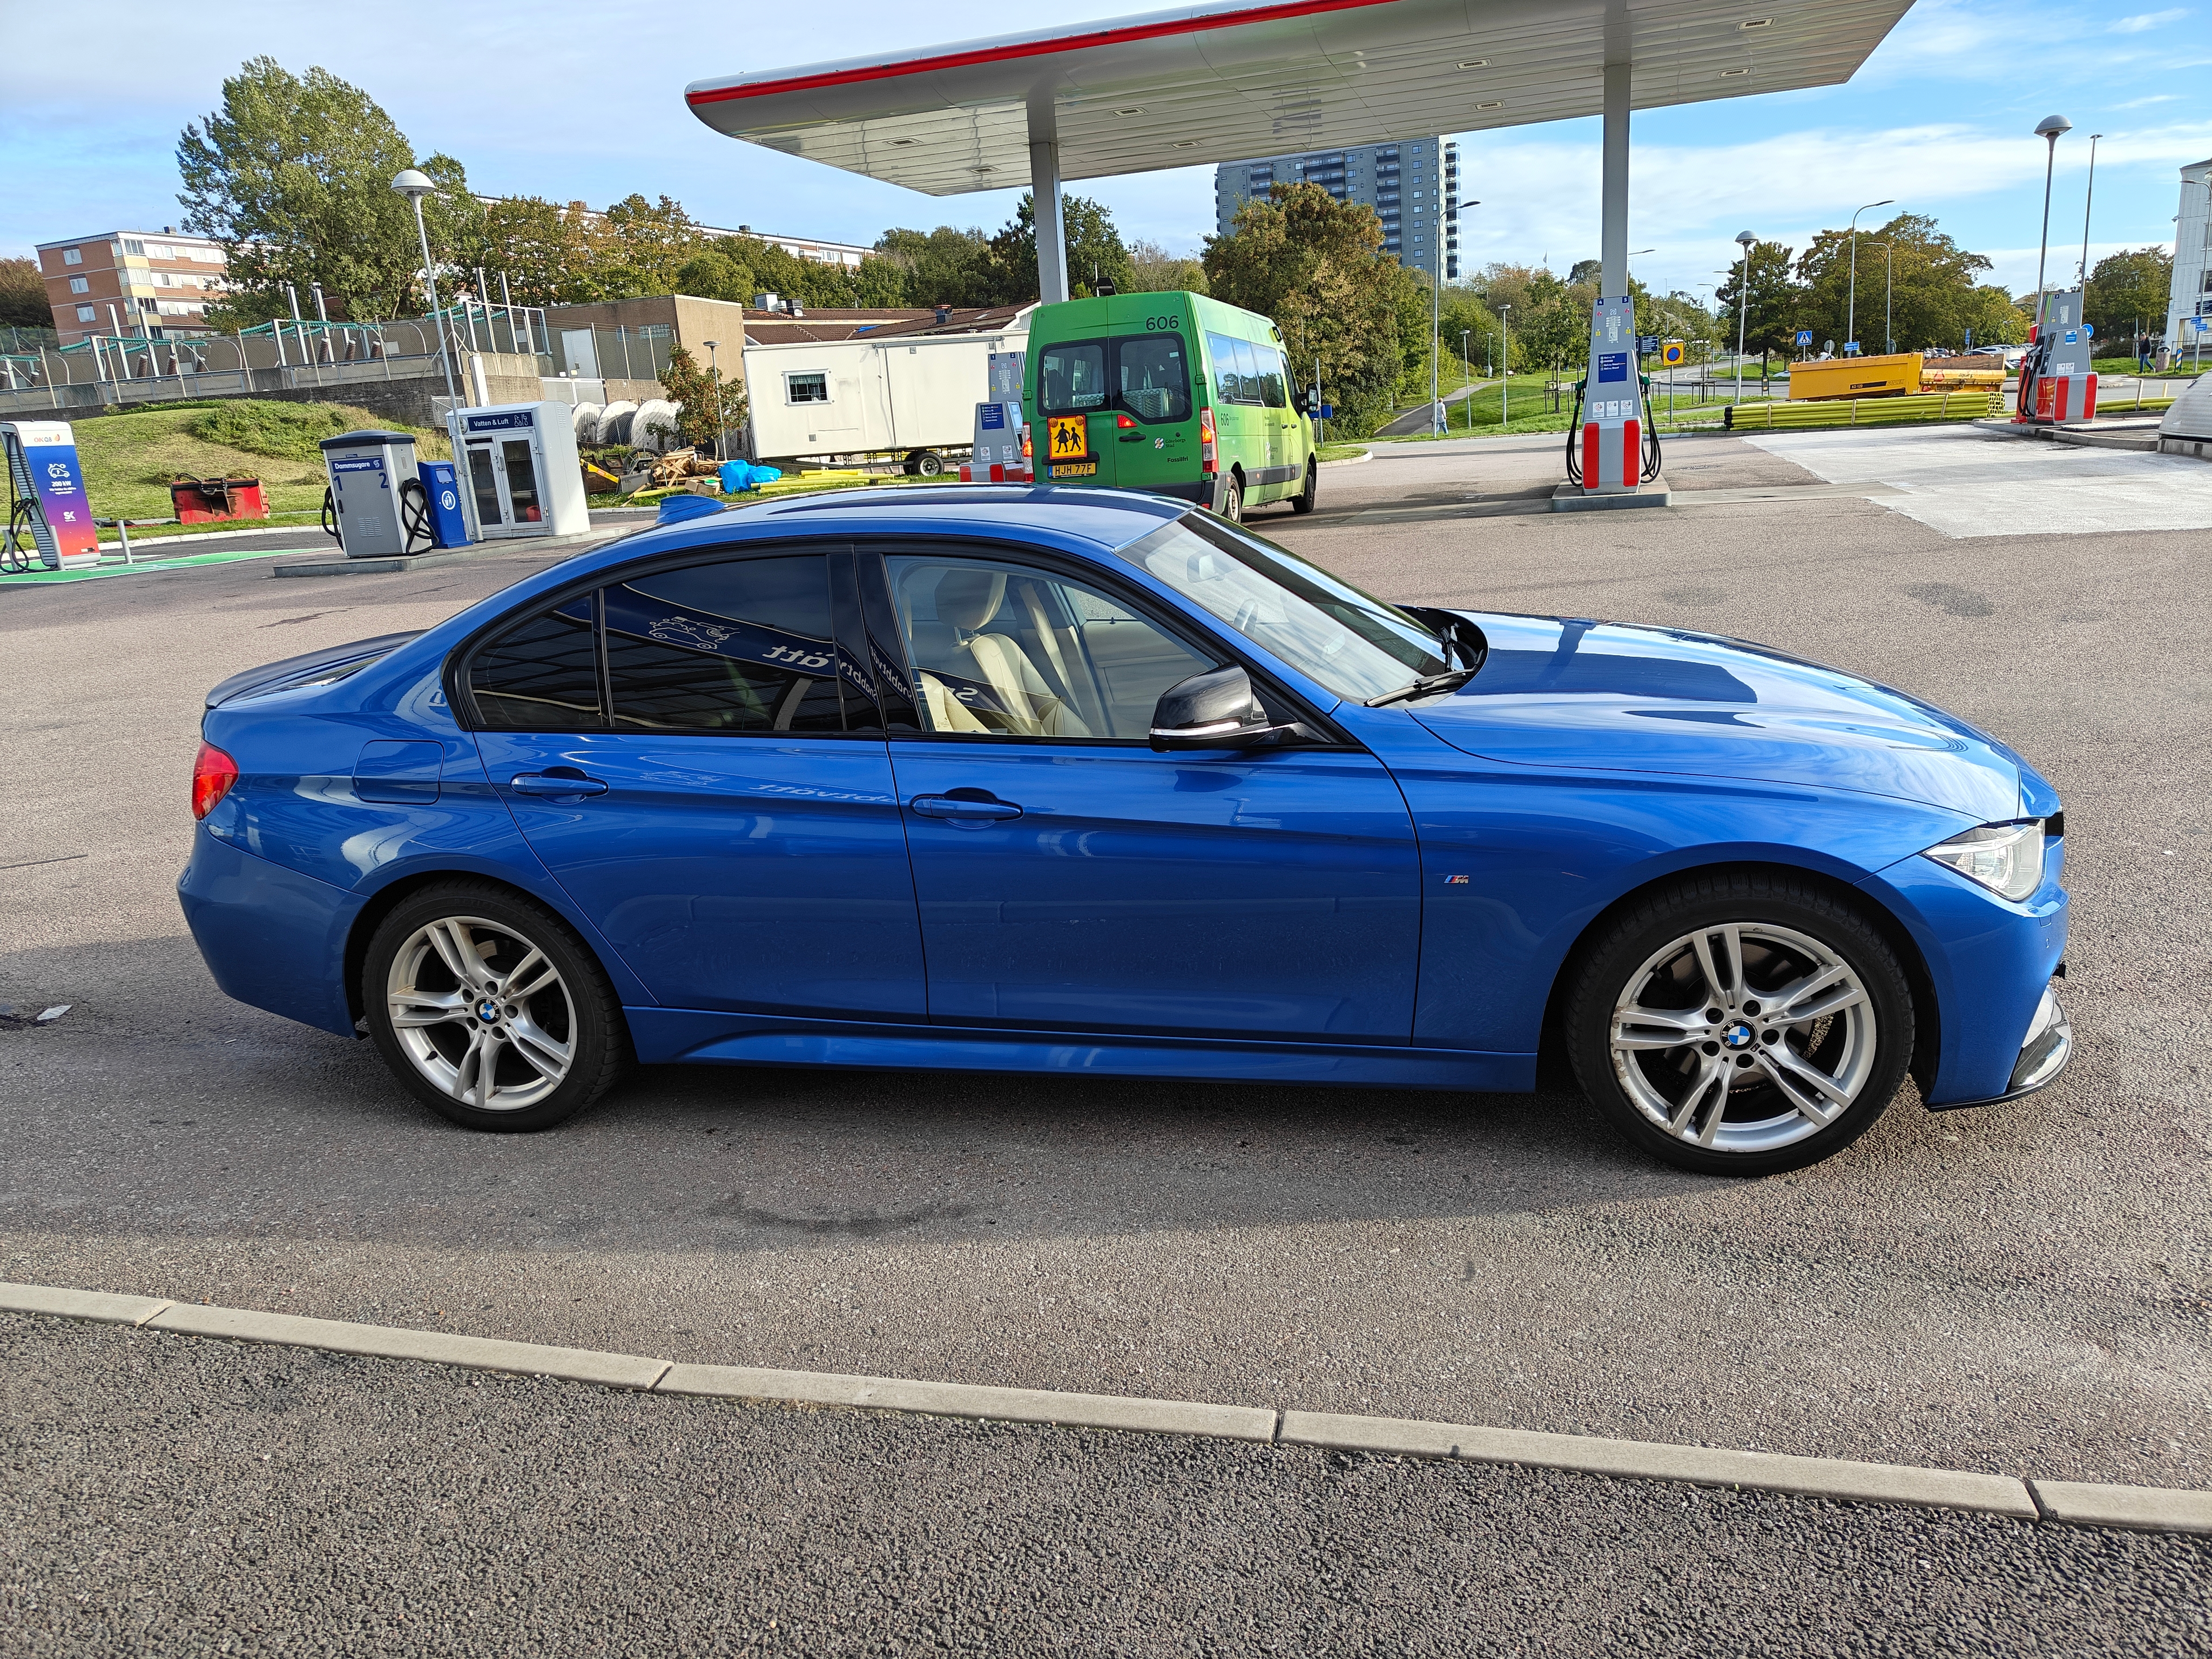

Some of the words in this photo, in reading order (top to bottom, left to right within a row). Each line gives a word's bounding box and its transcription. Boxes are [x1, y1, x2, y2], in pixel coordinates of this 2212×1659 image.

[1146, 315, 1179, 331] 606
[1220, 413, 1229, 426] 606
[1055, 465, 1072, 475] HJH
[1075, 464, 1092, 473] 77F
[333, 475, 343, 491] 1
[379, 472, 389, 488] 2
[486, 999, 501, 1020] BMW
[1722, 1021, 1735, 1047] BMW
